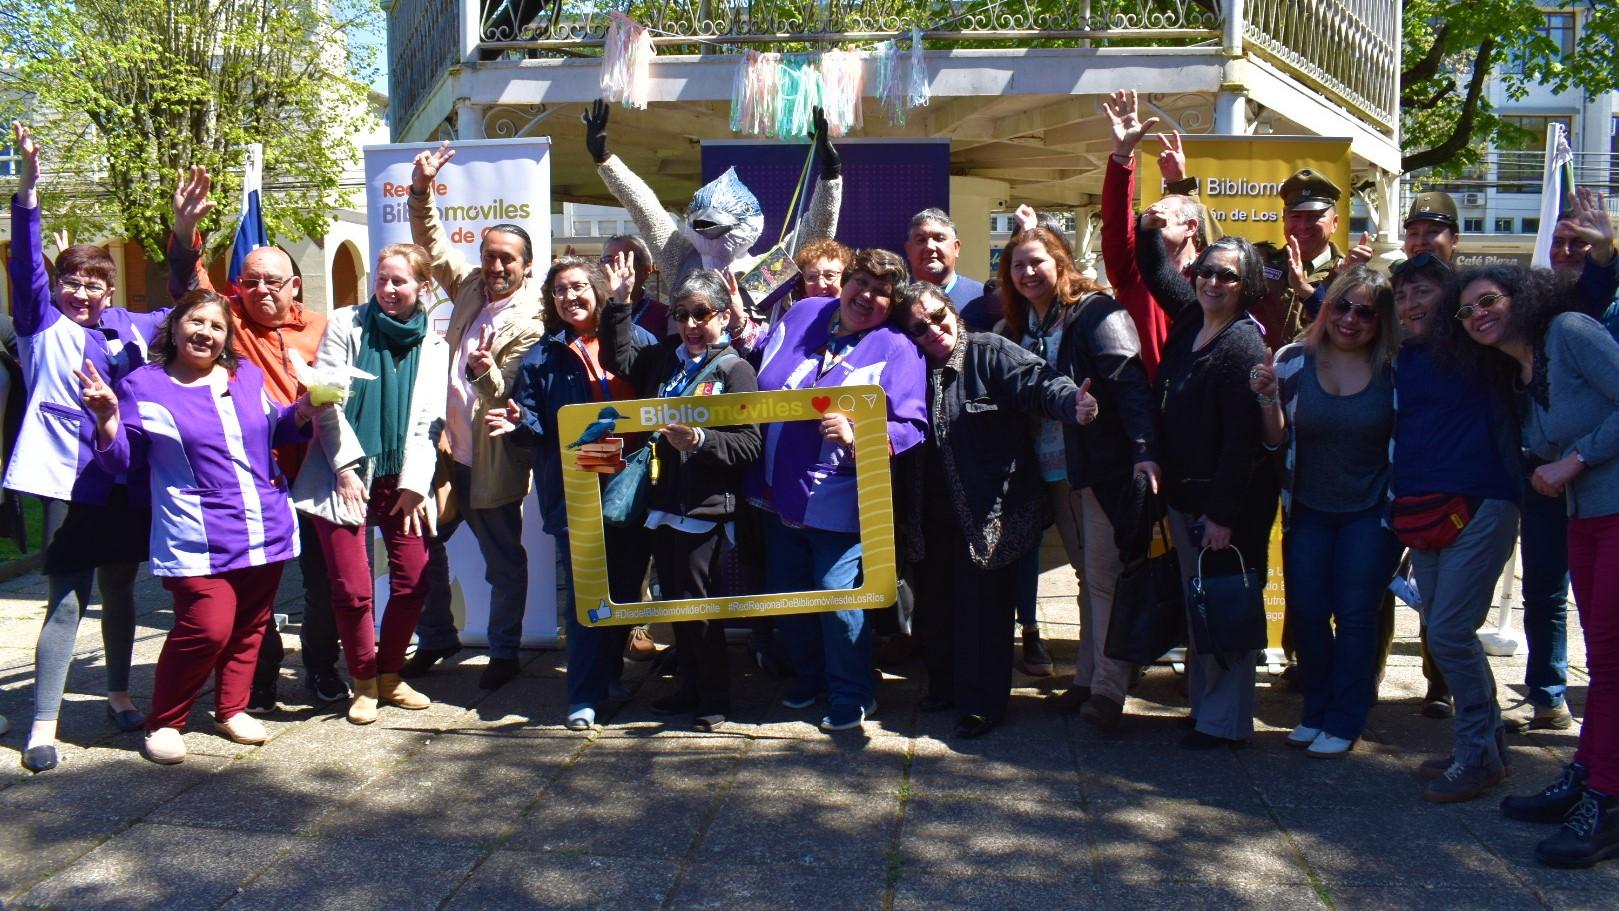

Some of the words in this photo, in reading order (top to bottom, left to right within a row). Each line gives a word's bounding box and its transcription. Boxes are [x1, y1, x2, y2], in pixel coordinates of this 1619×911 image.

[1230, 207, 1247, 220] de
[1251, 208, 1277, 221] Los
[450, 226, 475, 244] de
[1456, 255, 1483, 266] Café
[1265, 611, 1285, 622] ago
